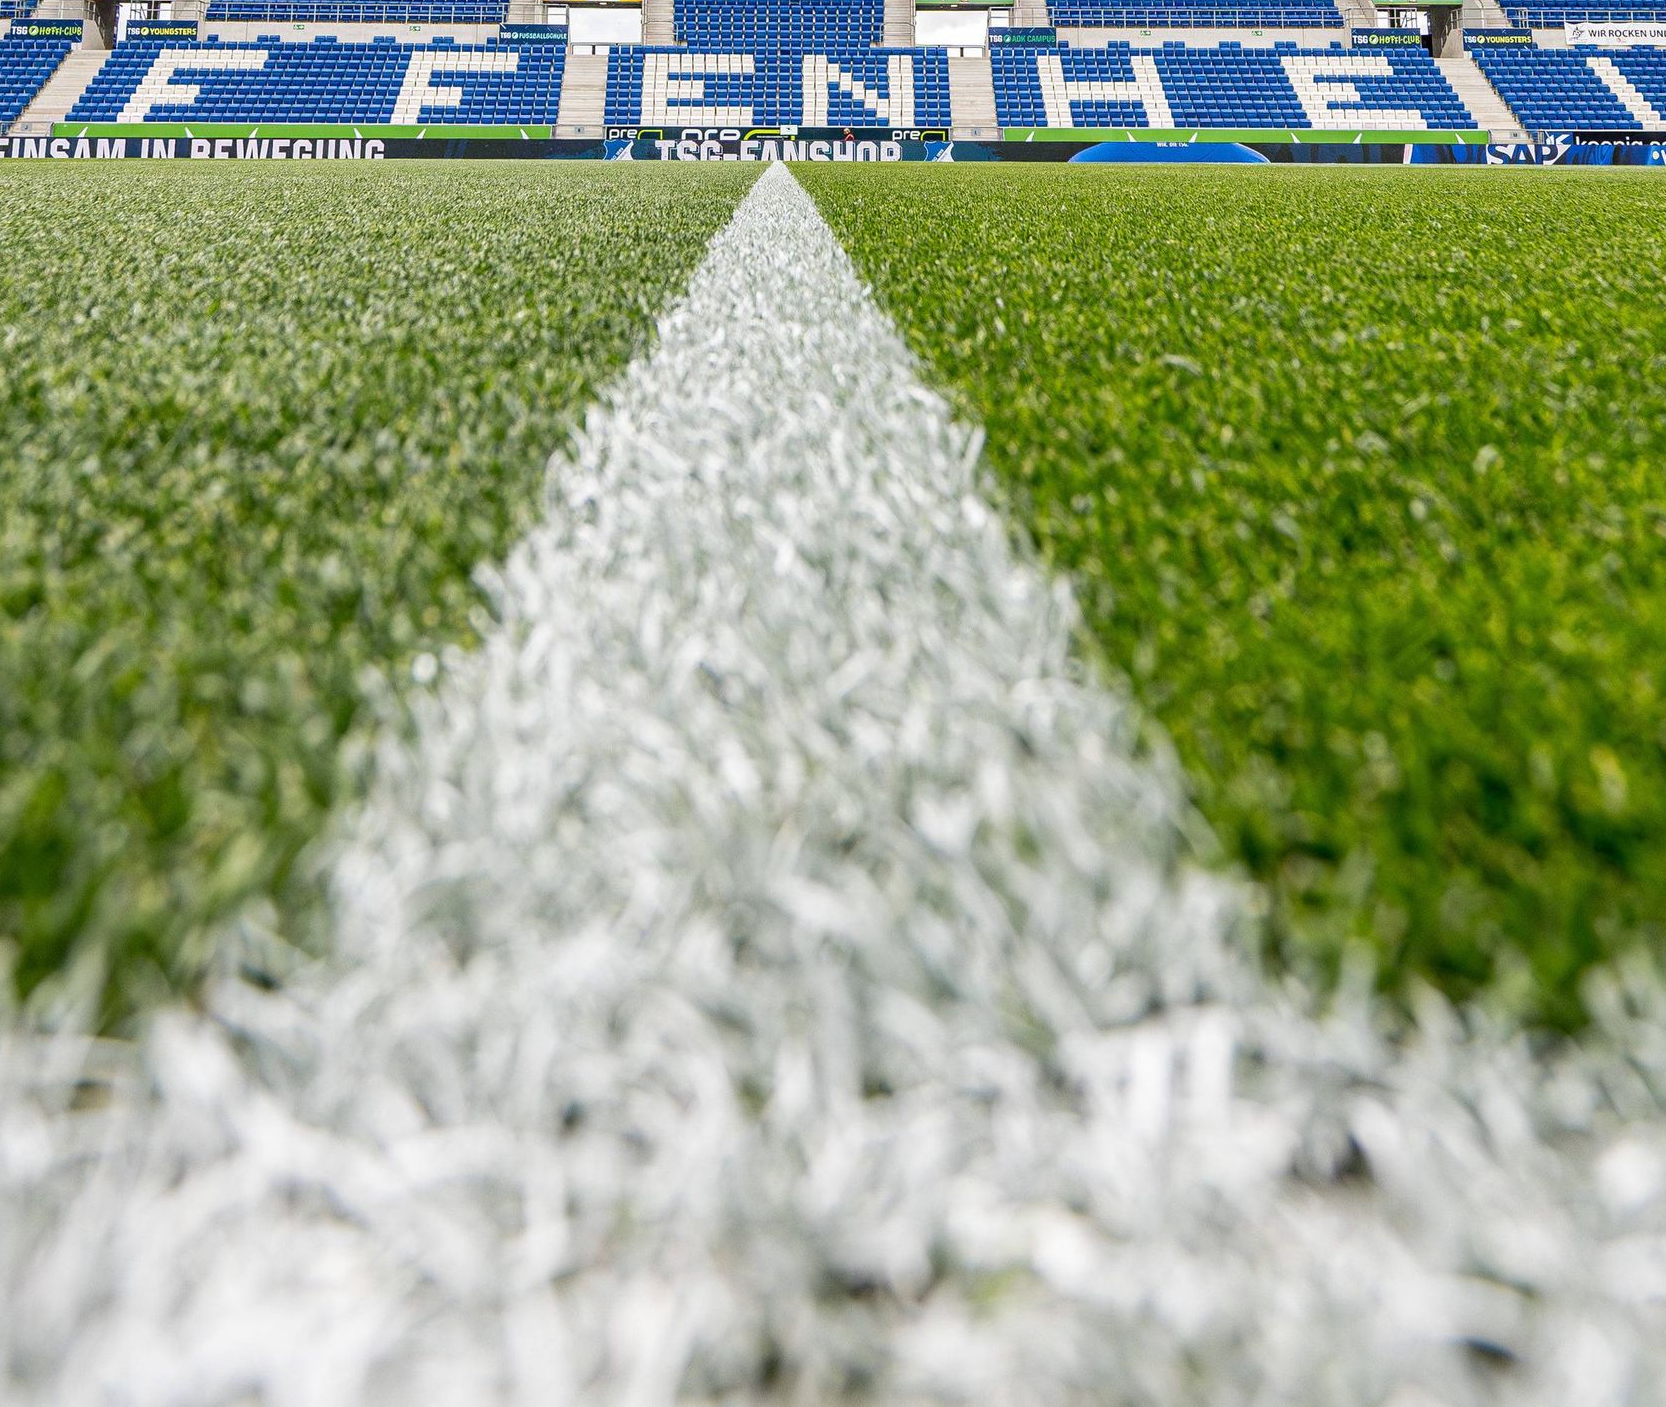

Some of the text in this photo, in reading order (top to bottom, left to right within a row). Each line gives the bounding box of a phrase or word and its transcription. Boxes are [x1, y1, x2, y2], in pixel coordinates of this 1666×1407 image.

[11, 26, 28, 35] TSG
[127, 27, 197, 36] TSG YOUNGSTERS
[1588, 29, 1607, 38] WIR
[1608, 29, 1647, 38] ROCKEN
[500, 31, 567, 40] TSG FUSSBALLSCHULE
[989, 35, 1056, 43] TSG AOK CAMPUS
[1352, 35, 1368, 44] TSG
[1463, 36, 1532, 44] TSG YOUNGSTERS
[140, 138, 176, 159] IN
[1487, 144, 1558, 165] SAP
